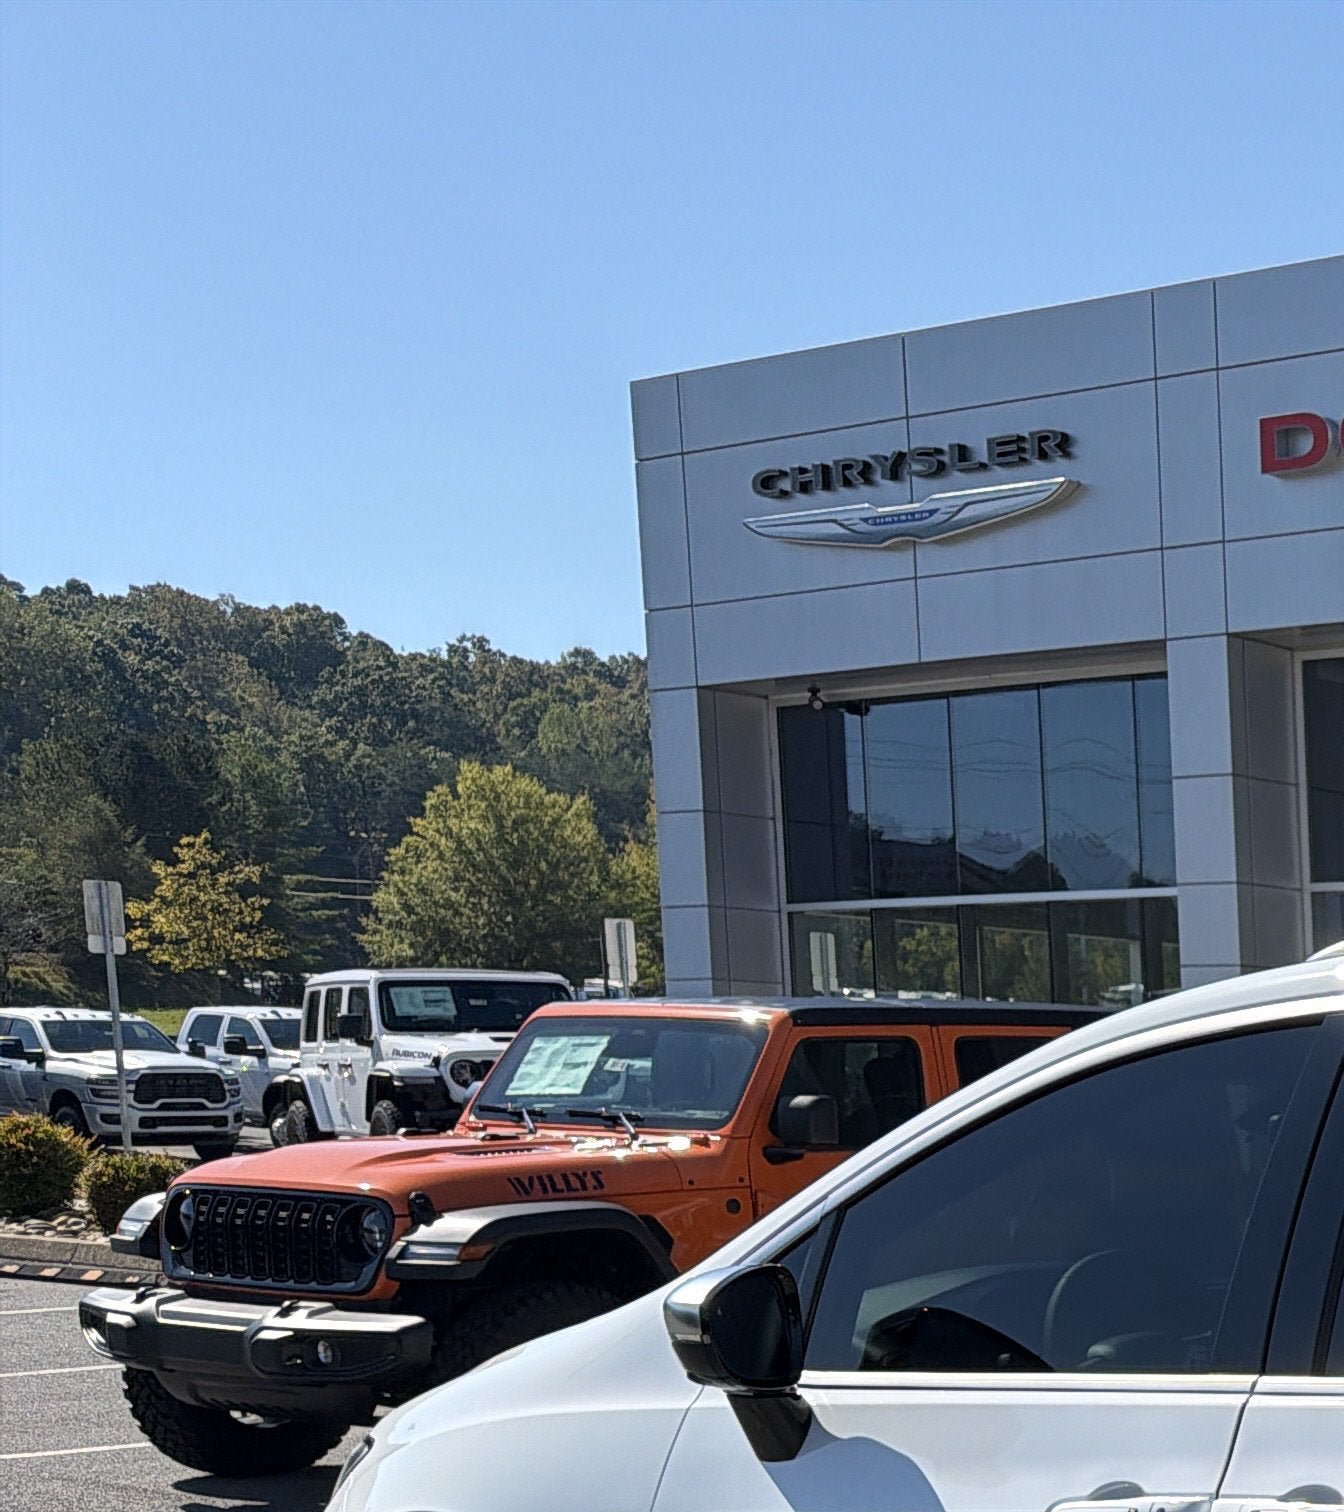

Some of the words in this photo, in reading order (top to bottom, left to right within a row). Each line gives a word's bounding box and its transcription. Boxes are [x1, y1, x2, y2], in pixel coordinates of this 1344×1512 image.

[751, 428, 1073, 499] CHRYSLER
[391, 1048, 432, 1060] RUBICON
[507, 1168, 605, 1197] WILLYS
